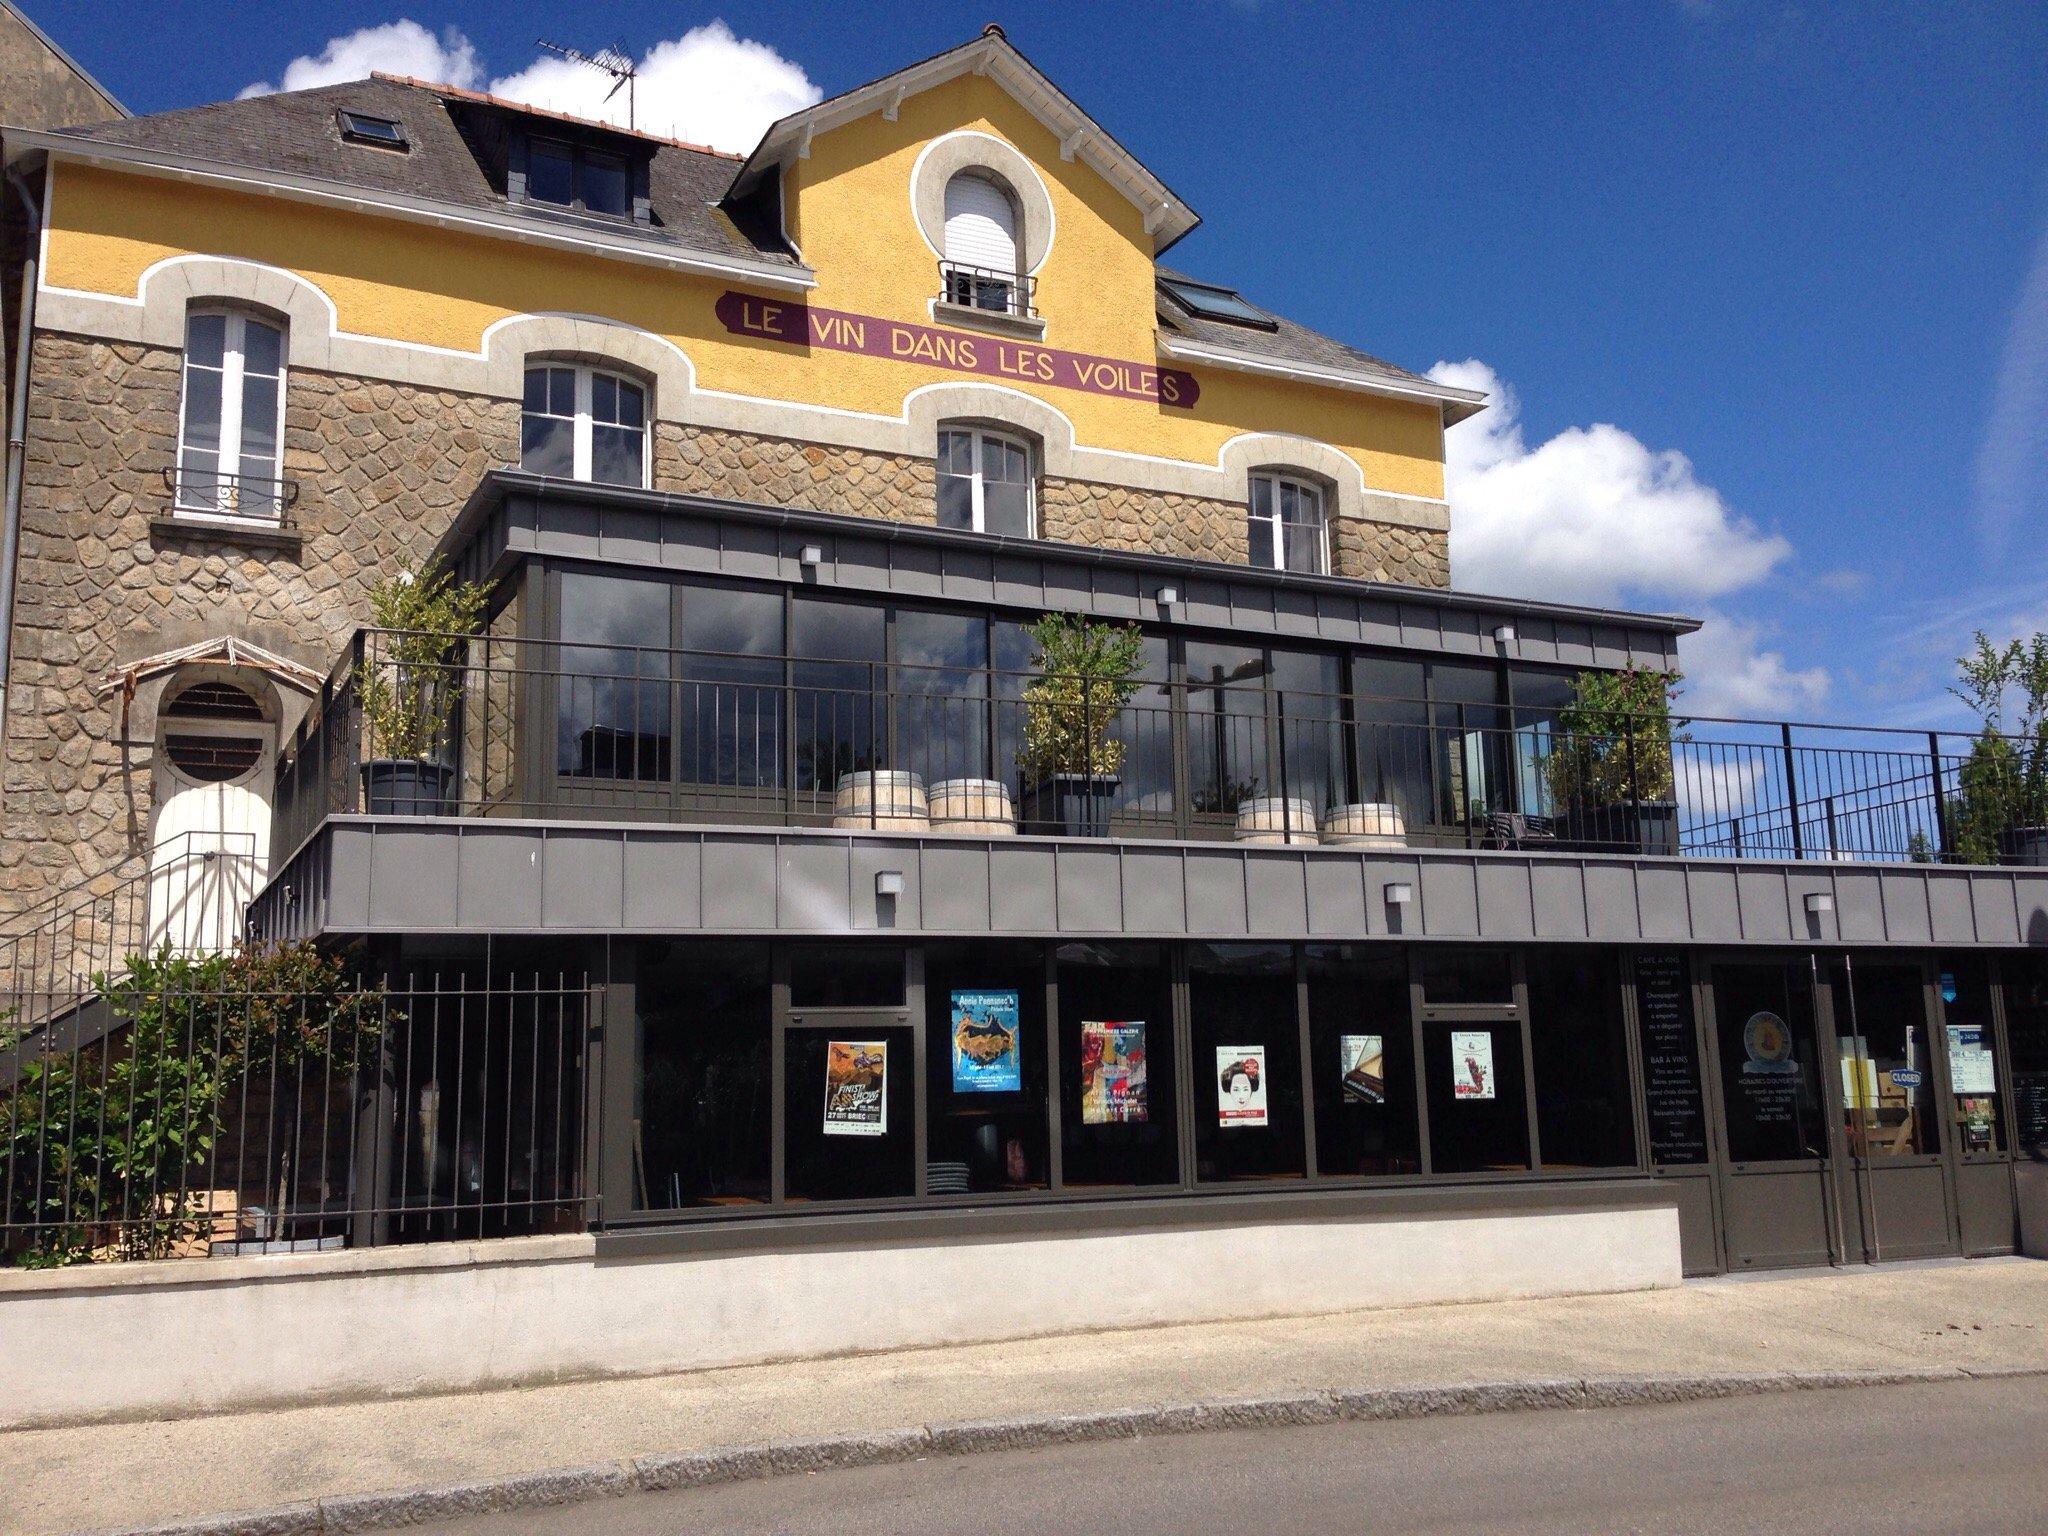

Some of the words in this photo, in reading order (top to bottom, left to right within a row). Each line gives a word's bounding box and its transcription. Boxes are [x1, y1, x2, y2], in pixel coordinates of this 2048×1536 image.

[743, 302, 784, 334] LE
[811, 313, 865, 350] VIN
[893, 327, 978, 369] DANS
[1000, 346, 1055, 382] LES
[1073, 359, 1182, 402] VOILES
[1672, 1055, 1688, 1064] VINS
[1892, 1073, 1920, 1083] CLOSED
[848, 1112, 866, 1120] BRIEC
